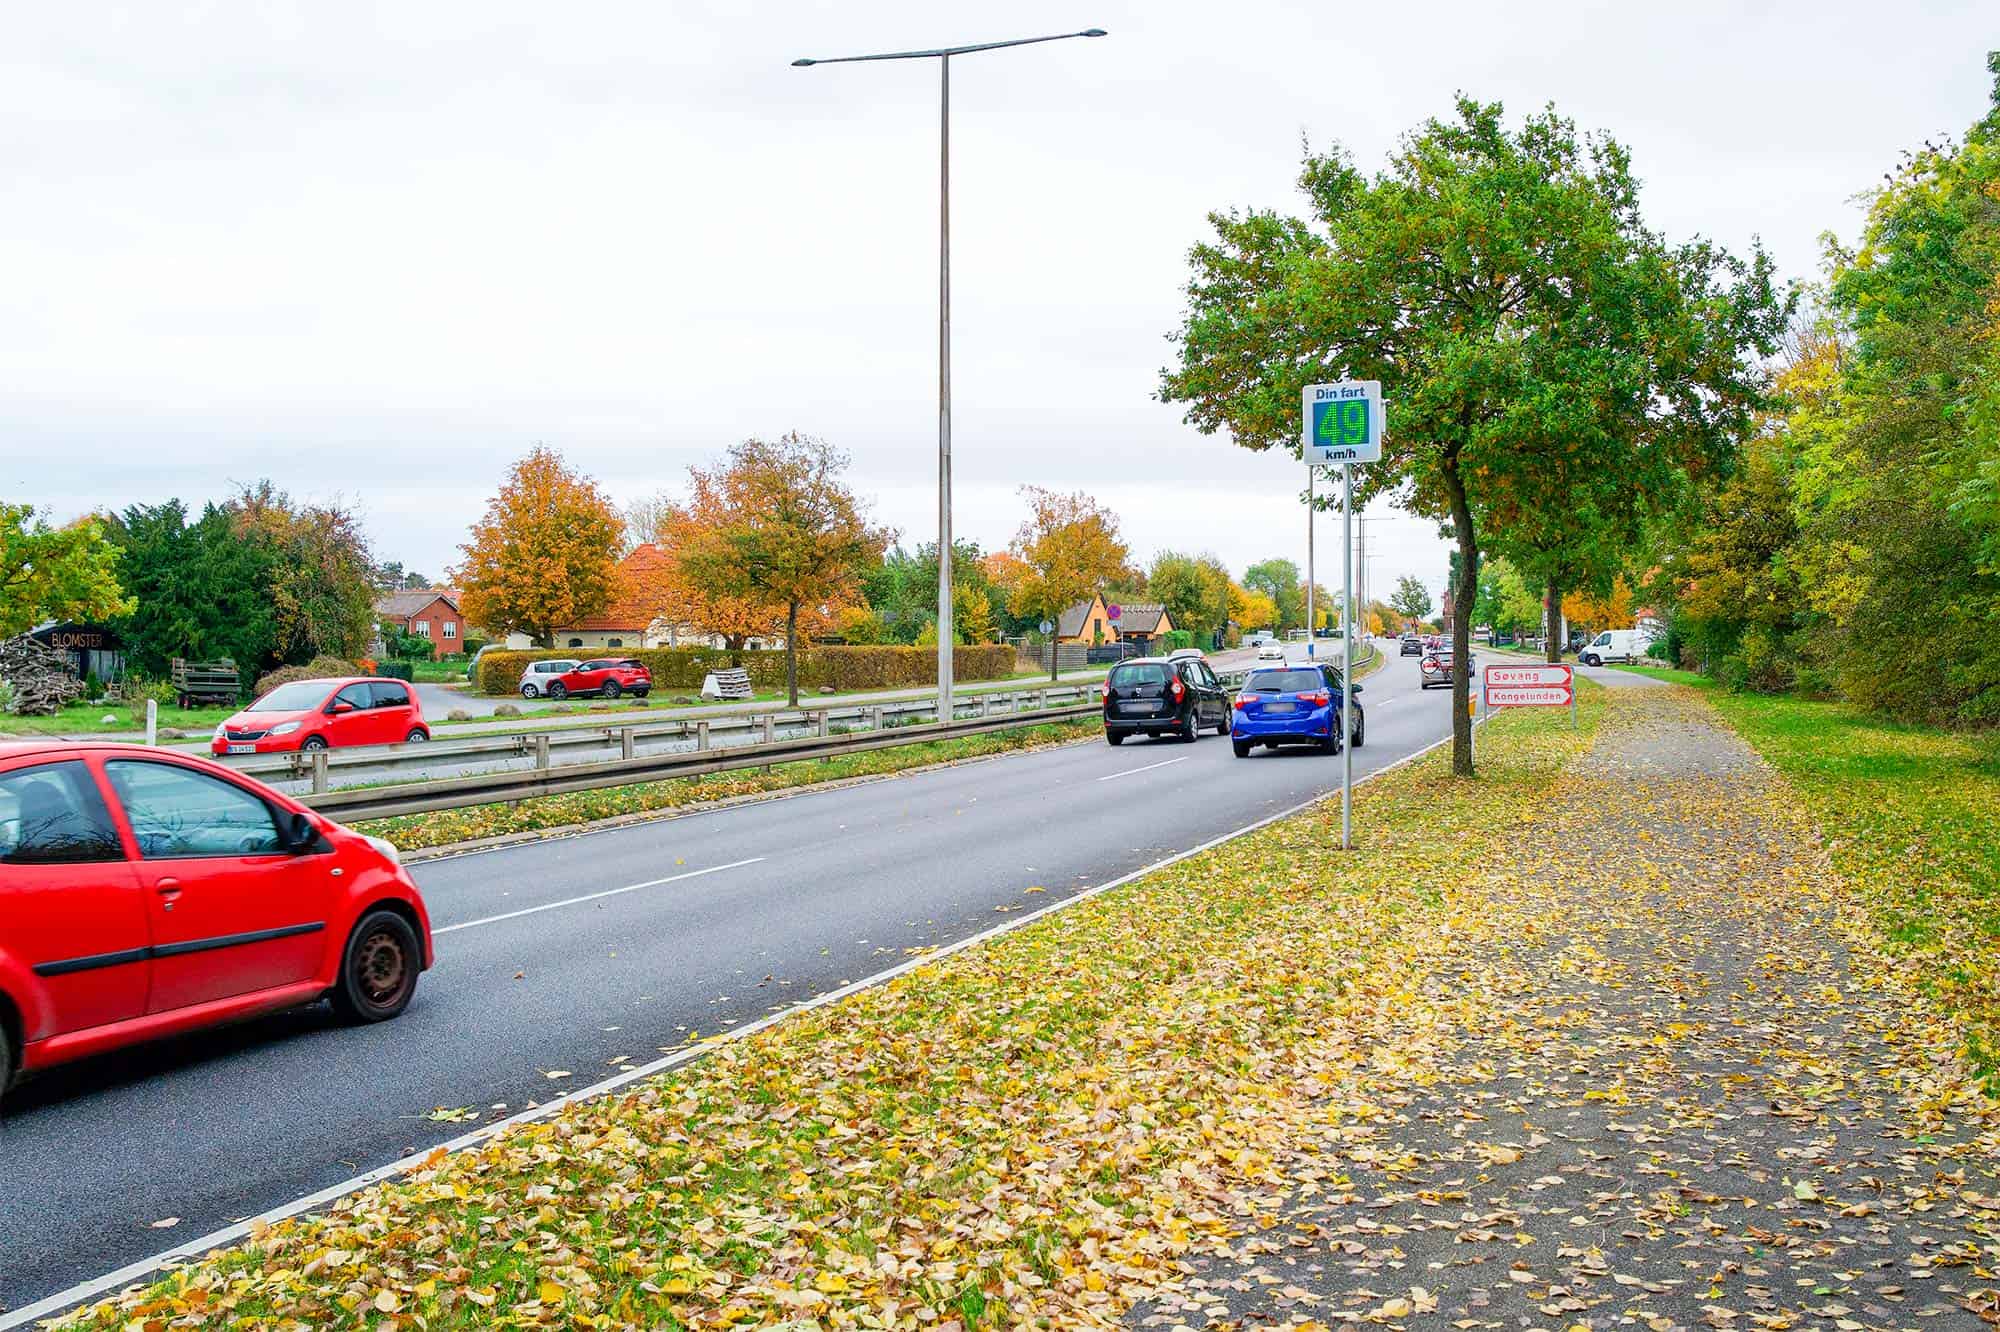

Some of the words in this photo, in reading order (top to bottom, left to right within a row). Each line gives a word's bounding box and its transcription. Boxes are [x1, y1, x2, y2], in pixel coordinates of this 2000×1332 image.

[1316, 389, 1337, 399] Din
[1341, 387, 1365, 397] fart
[1319, 401, 1364, 445] 49
[1325, 449, 1356, 459] km/h
[52, 633, 102, 647] BLOMSTER
[1494, 692, 1561, 701] Kongelunden
